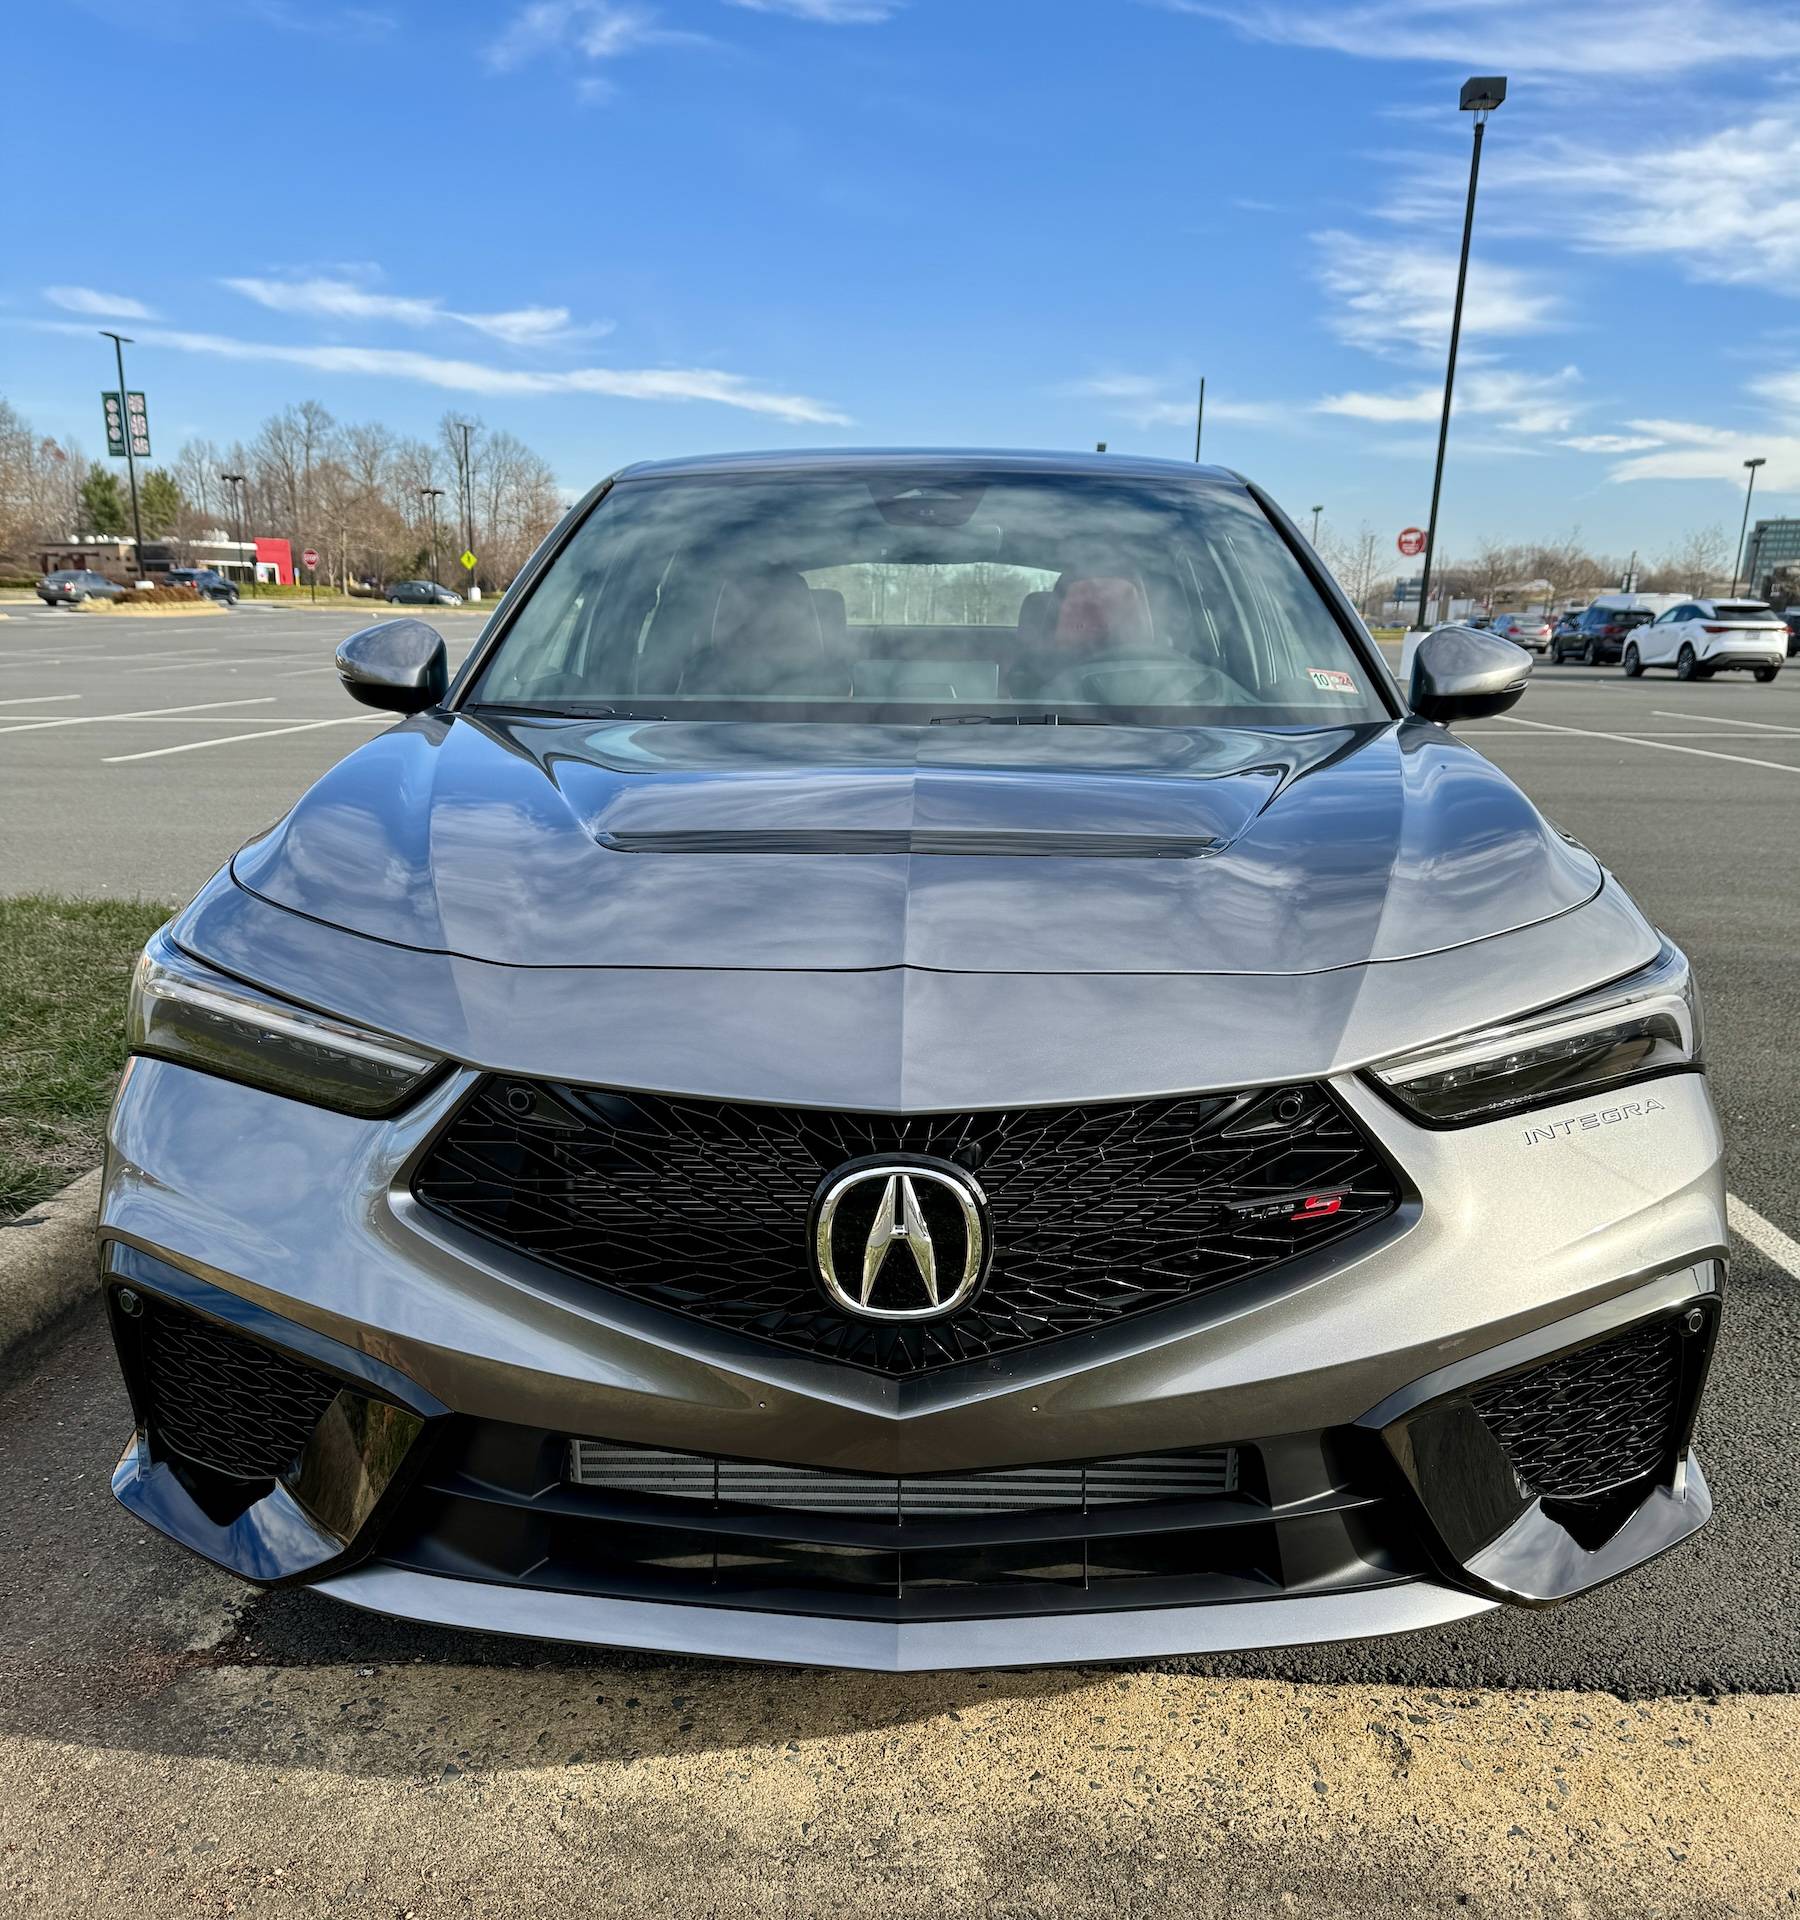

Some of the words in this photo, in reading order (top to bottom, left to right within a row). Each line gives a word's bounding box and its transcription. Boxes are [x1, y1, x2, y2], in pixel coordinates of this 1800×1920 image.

[1313, 673, 1329, 686] 10
[1522, 1098, 1665, 1145] INTEGRA
[1290, 1196, 1342, 1220] S
